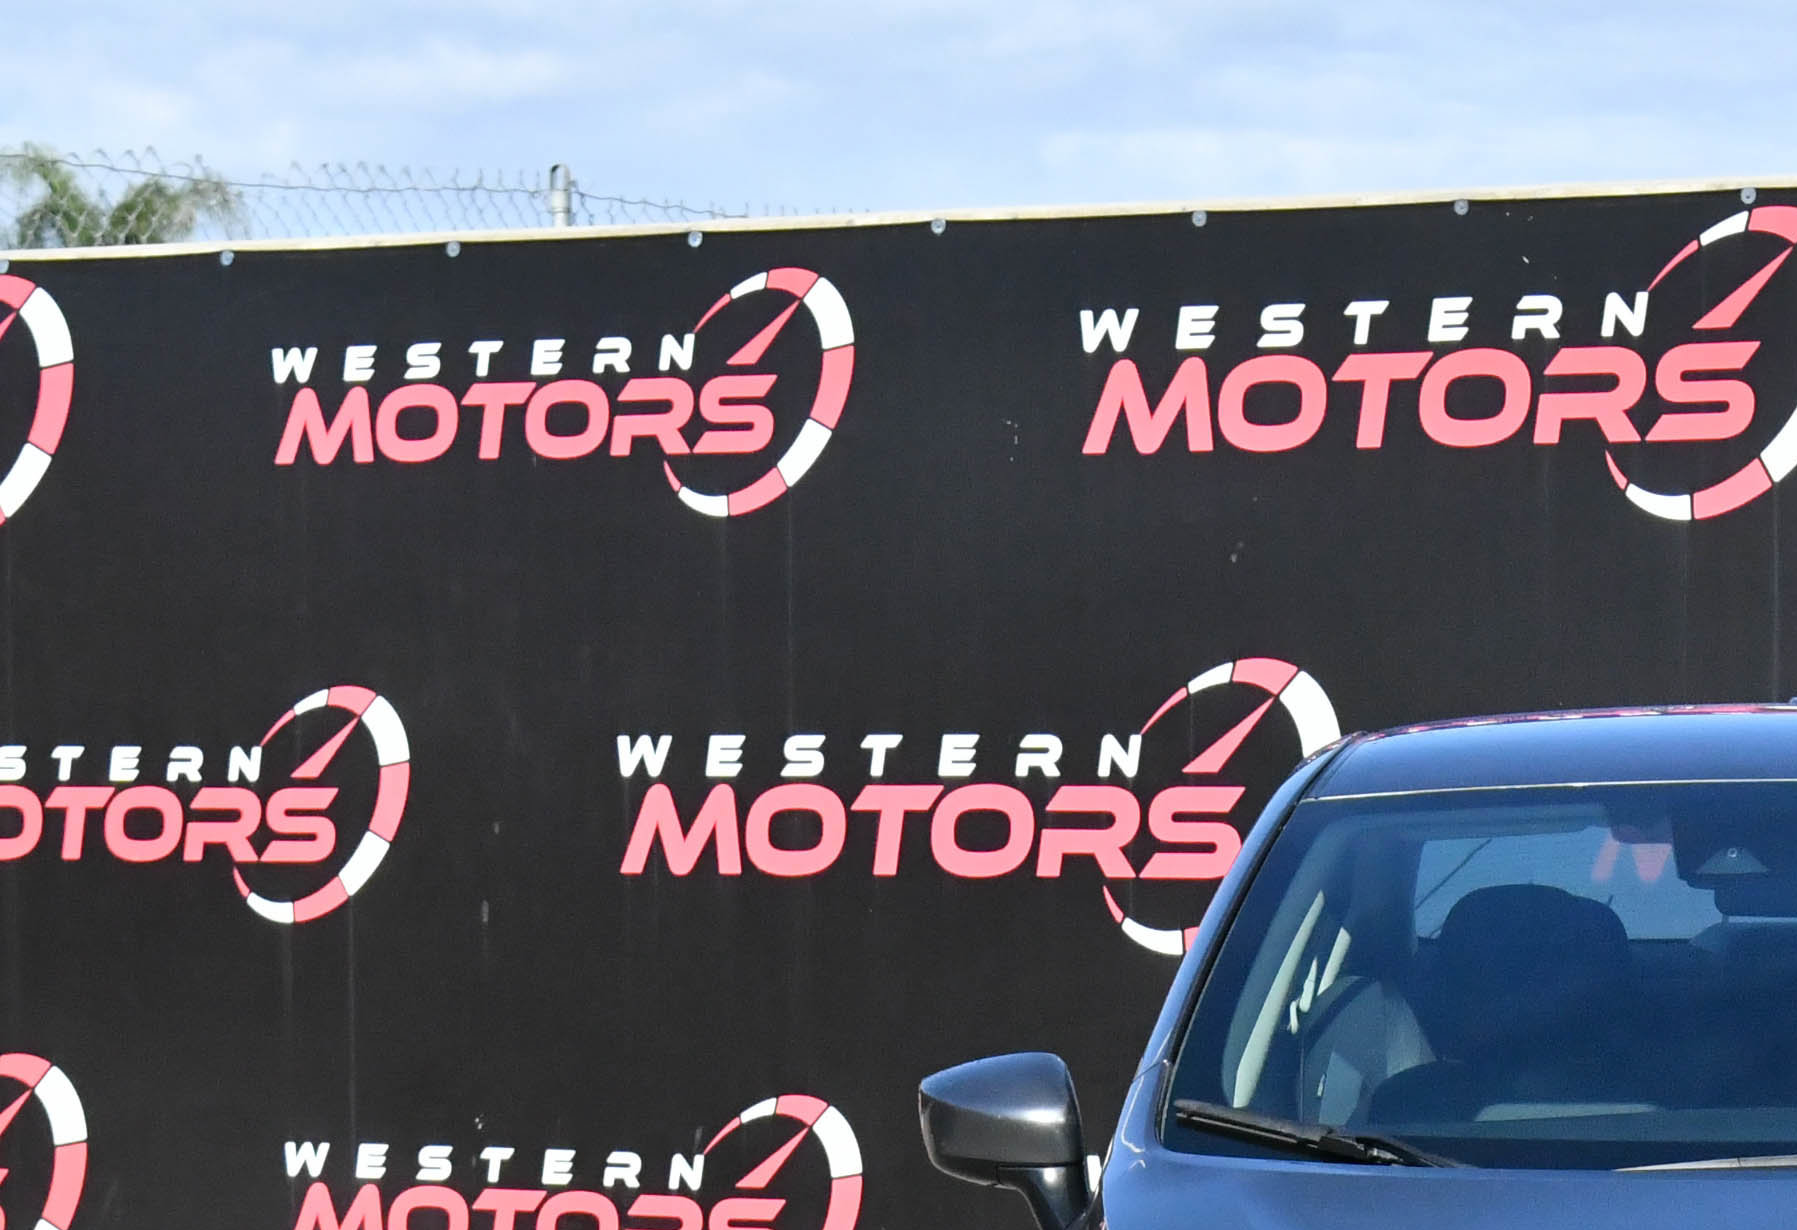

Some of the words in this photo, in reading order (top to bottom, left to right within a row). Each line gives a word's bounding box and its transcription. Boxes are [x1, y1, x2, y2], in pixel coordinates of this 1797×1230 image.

[1080, 291, 1649, 354] WESTERN
[271, 333, 696, 385] WESTERN
[274, 374, 778, 466] MOTORS
[1081, 341, 1761, 455] MOTORS
[616, 733, 1142, 779] WESTERN
[619, 783, 1246, 881] MOTORS
[284, 1141, 705, 1191] WESTERN
